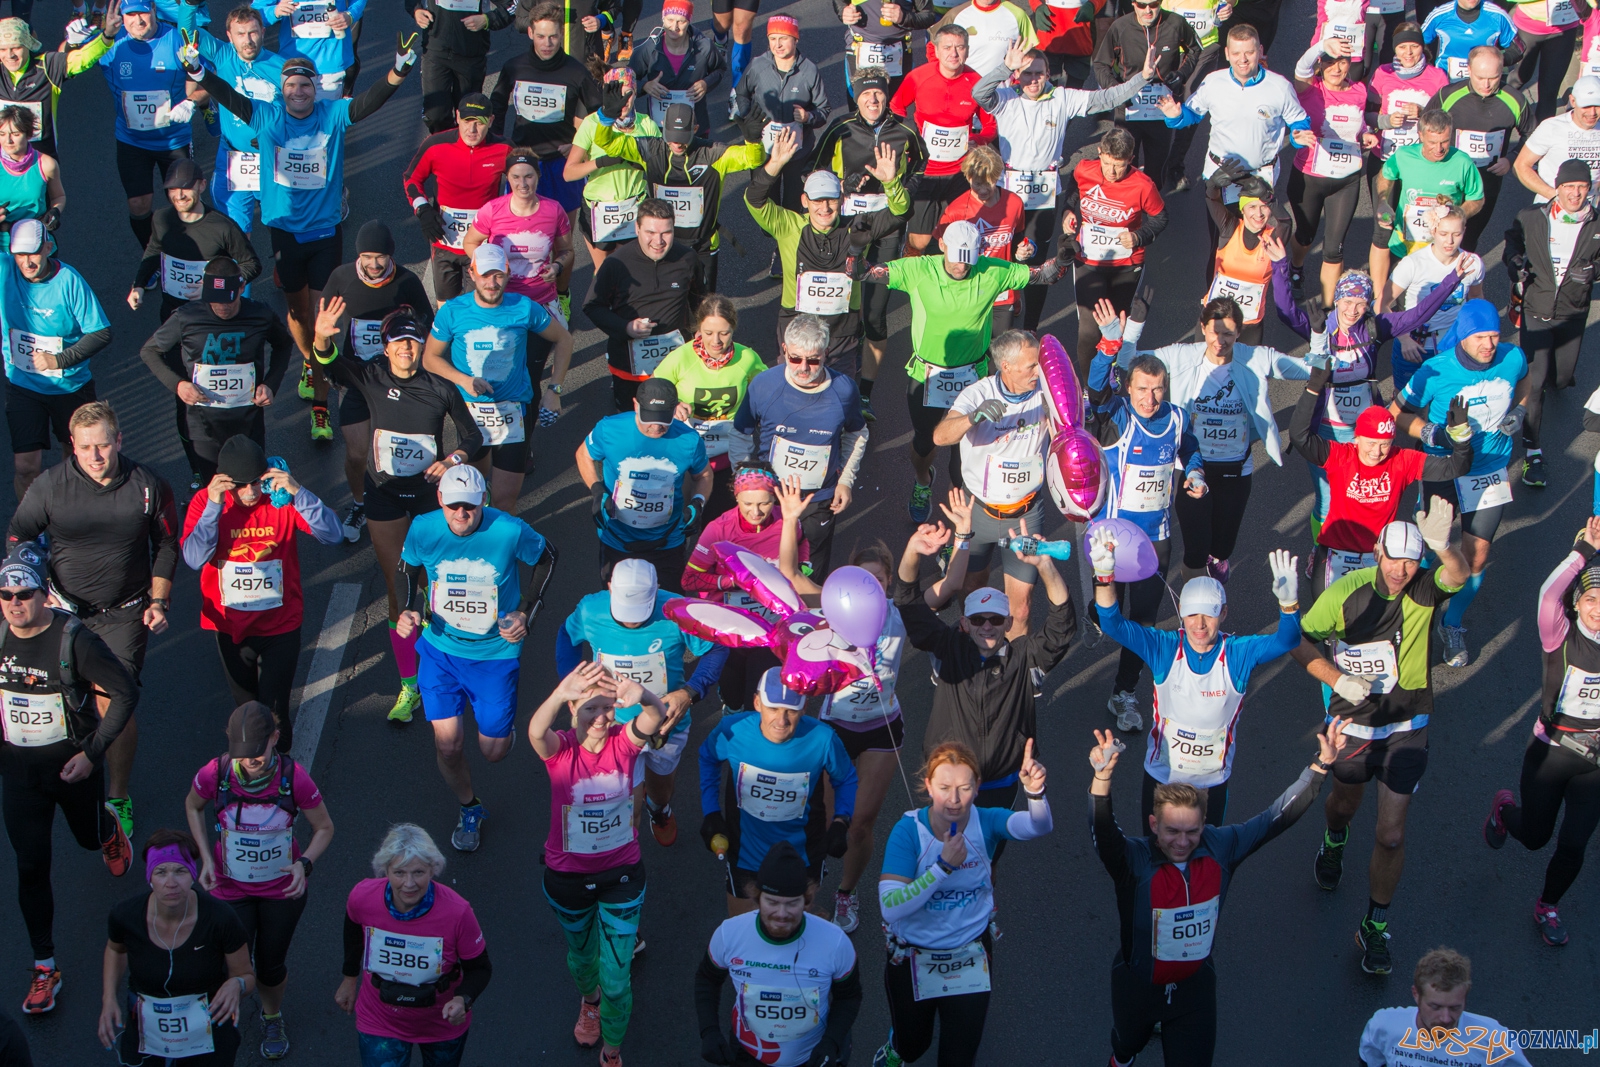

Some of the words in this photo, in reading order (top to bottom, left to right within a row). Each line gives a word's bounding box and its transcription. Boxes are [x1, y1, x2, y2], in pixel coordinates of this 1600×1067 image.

[524, 94, 557, 108] 6333
[136, 104, 157, 114] 170
[931, 136, 961, 148] 6972
[1469, 144, 1494, 153] 950
[1328, 152, 1352, 164] 1991
[284, 161, 320, 174] 2968
[1015, 183, 1048, 195] 2080
[603, 212, 634, 225] 6570
[1090, 234, 1122, 246] 2072
[170, 269, 203, 284] 3262
[808, 286, 844, 298] 6622
[208, 379, 244, 391] 3921
[1334, 395, 1361, 407] 700
[1196, 404, 1243, 415] SZNURKU
[476, 413, 514, 427] 3556
[1202, 428, 1238, 440] 1494
[390, 446, 424, 461] 1874
[784, 454, 818, 472] 1247
[1002, 471, 1030, 484] 1681
[1470, 473, 1502, 491] 2318
[1135, 480, 1165, 493] 4719
[624, 498, 664, 513] 5288
[231, 526, 274, 539] MOTOR
[230, 576, 273, 591] 4976
[443, 600, 487, 614] 4563
[1344, 659, 1385, 674] 3939
[850, 691, 880, 705] 275
[1201, 690, 1226, 698] TIMEX
[10, 709, 53, 725] 6023
[1171, 737, 1214, 756] 7085
[750, 784, 798, 803] 6239
[580, 815, 622, 834] 1654
[236, 846, 282, 863] 2905
[1172, 918, 1211, 940] 6013
[386, 938, 404, 947] 16.PKO
[378, 948, 430, 970] 3386
[746, 961, 791, 970] EUROCASH
[924, 957, 976, 976] 7084
[154, 1004, 171, 1012] 16.PKO
[754, 1004, 806, 1021] 6509
[158, 1017, 188, 1034] 631
[1394, 1048, 1412, 1058] have
[1450, 1058, 1464, 1066] the
